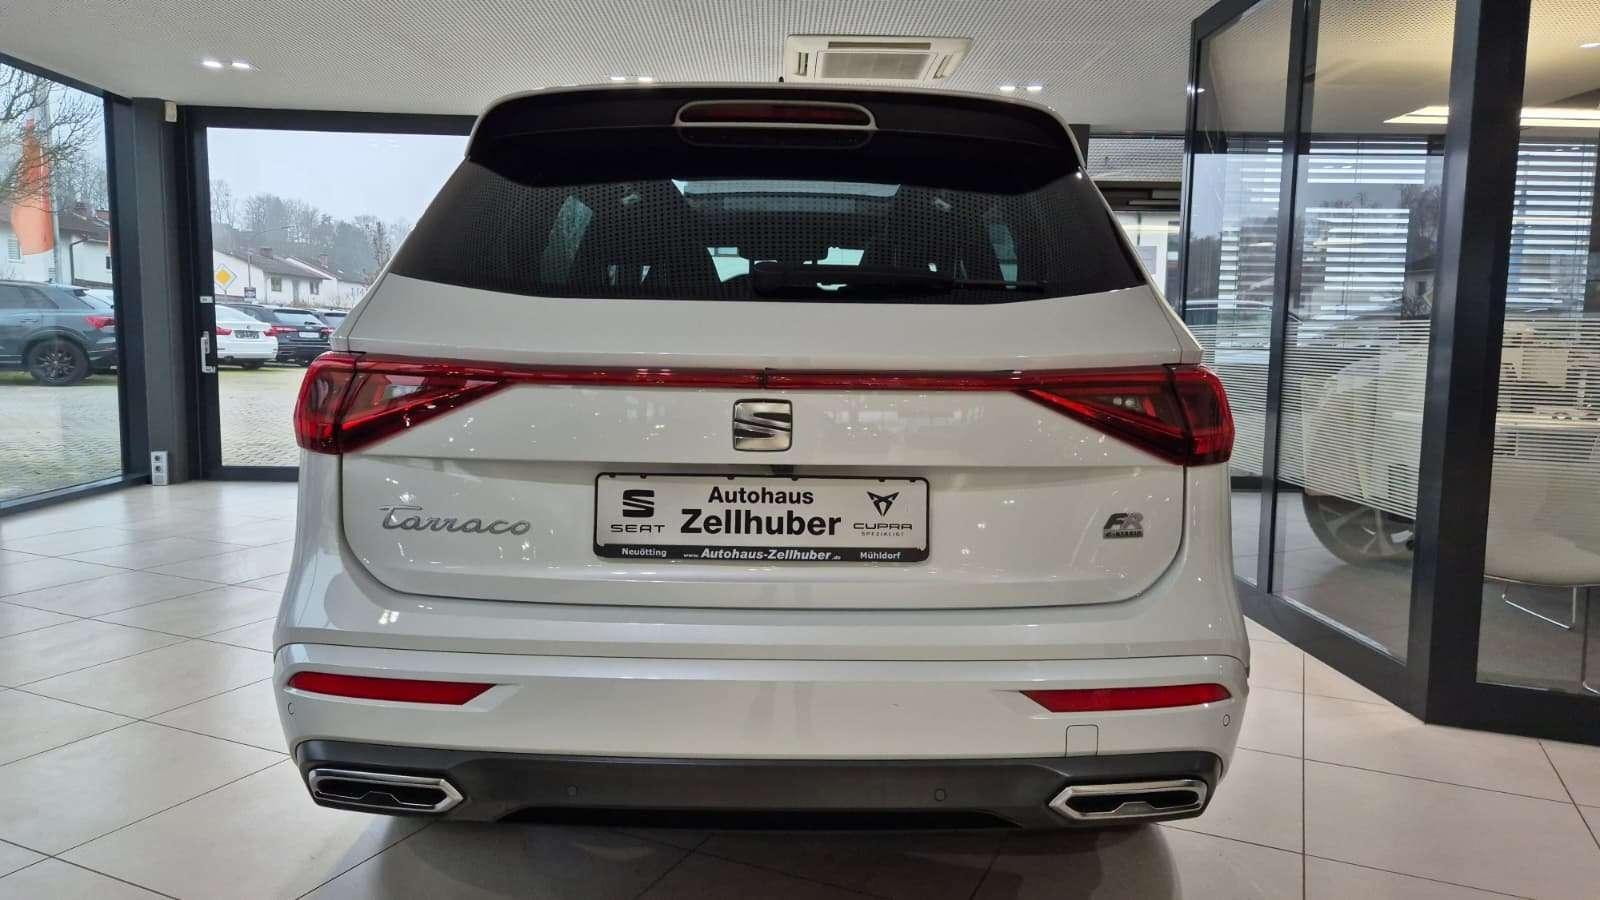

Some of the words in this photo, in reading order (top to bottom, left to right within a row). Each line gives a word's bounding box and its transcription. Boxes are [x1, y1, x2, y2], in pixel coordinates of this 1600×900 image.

[708, 486, 815, 505] Autohaus
[377, 504, 531, 535] Tarraco
[680, 508, 842, 536] Zellhuber
[611, 524, 666, 533] SEAT
[853, 522, 913, 530] CUPRA
[622, 547, 667, 558] Neuötting
[860, 551, 901, 560] Mühldorf
